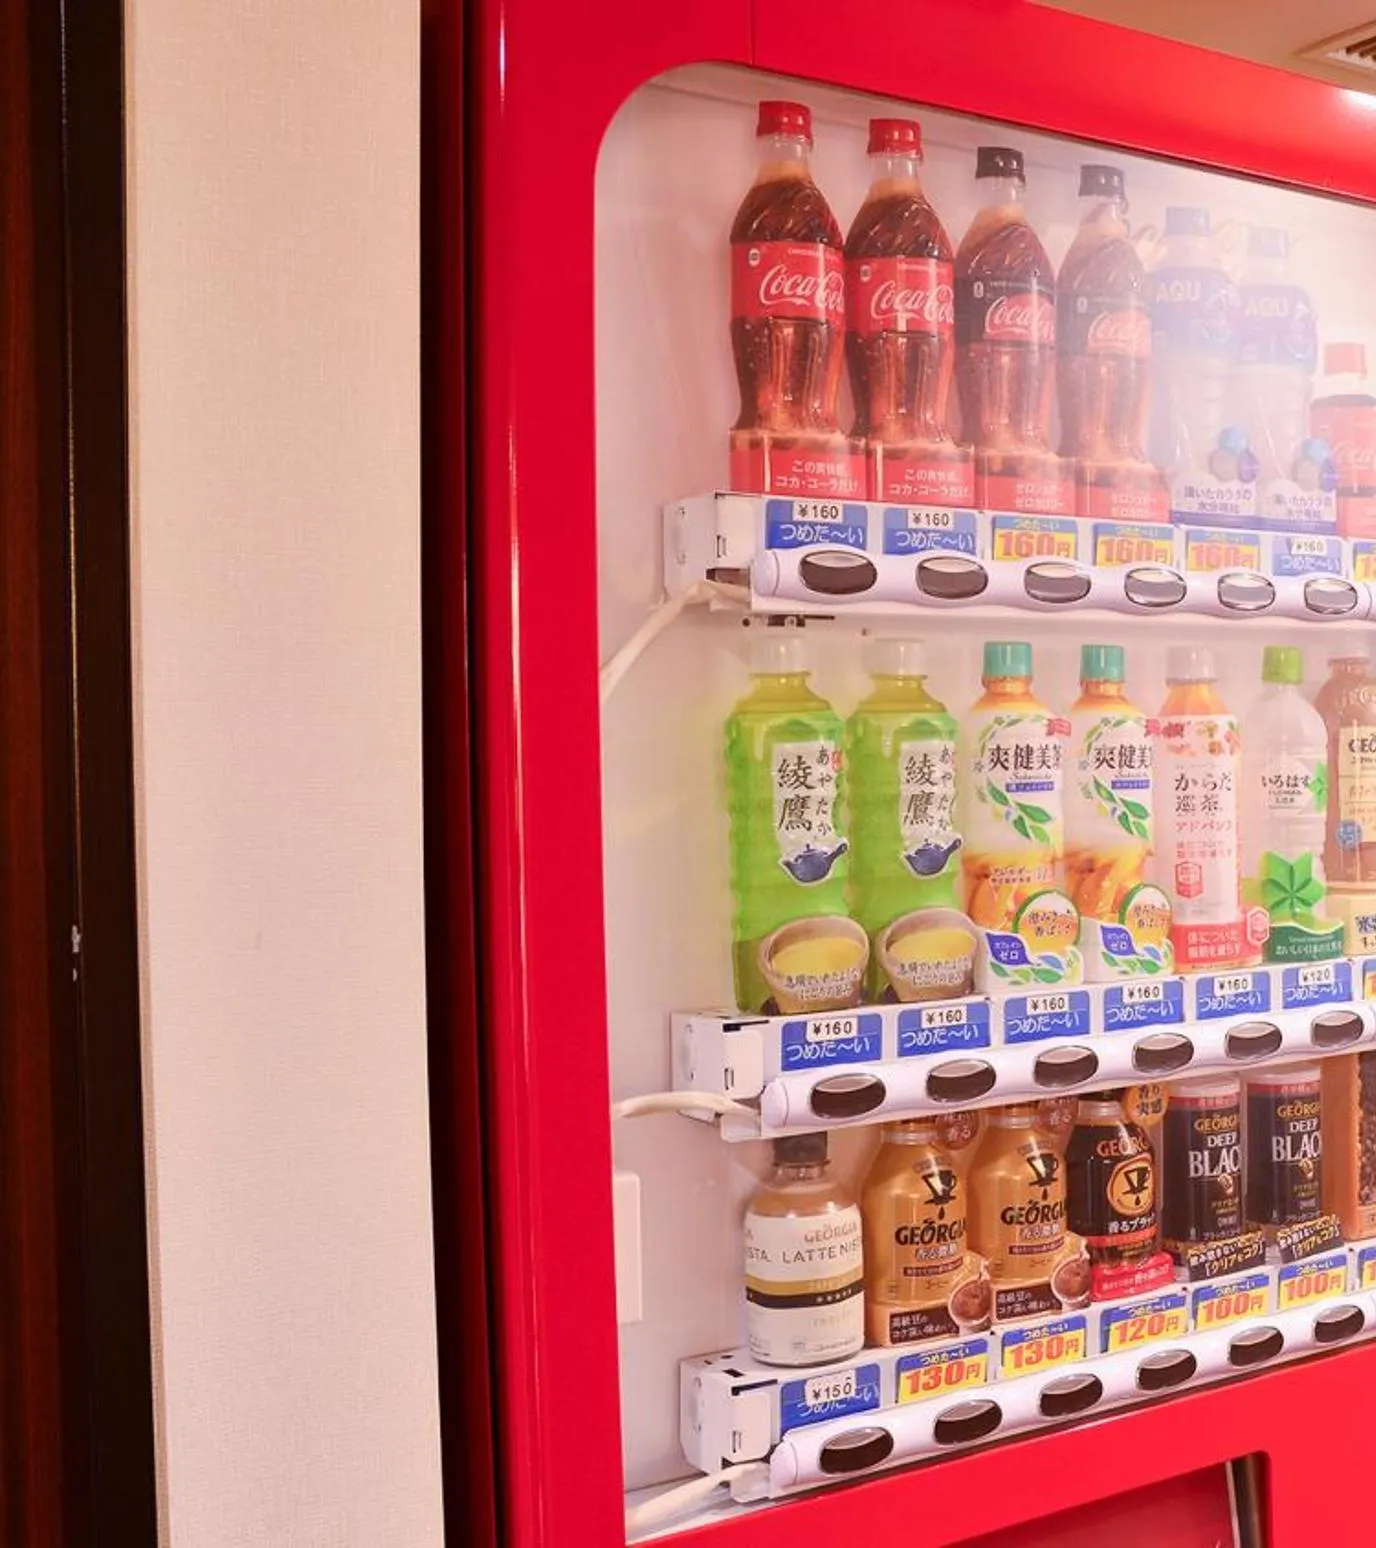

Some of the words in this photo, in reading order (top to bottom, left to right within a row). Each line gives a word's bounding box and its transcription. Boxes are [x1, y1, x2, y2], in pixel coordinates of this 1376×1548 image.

[797, 504, 840, 521] ¥160
[912, 512, 950, 528] ¥160
[998, 531, 1071, 559] 160円
[1099, 537, 1170, 565] 160円
[777, 754, 816, 832] 綾鷹
[814, 744, 834, 837] あやたか
[903, 752, 940, 827] 綾鷹
[1174, 772, 1232, 793] からだ
[999, 950, 1020, 961] ゼロ
[1030, 996, 1066, 1012] ¥160
[1127, 985, 1161, 1000] ¥160
[812, 1020, 853, 1036] ¥160
[924, 1008, 963, 1025] ¥160
[1283, 1272, 1342, 1302] 100円
[1201, 1292, 1265, 1324] 100円
[1114, 1312, 1179, 1344] 120円
[1011, 1336, 1080, 1369] 130円
[905, 1361, 981, 1395] 130円
